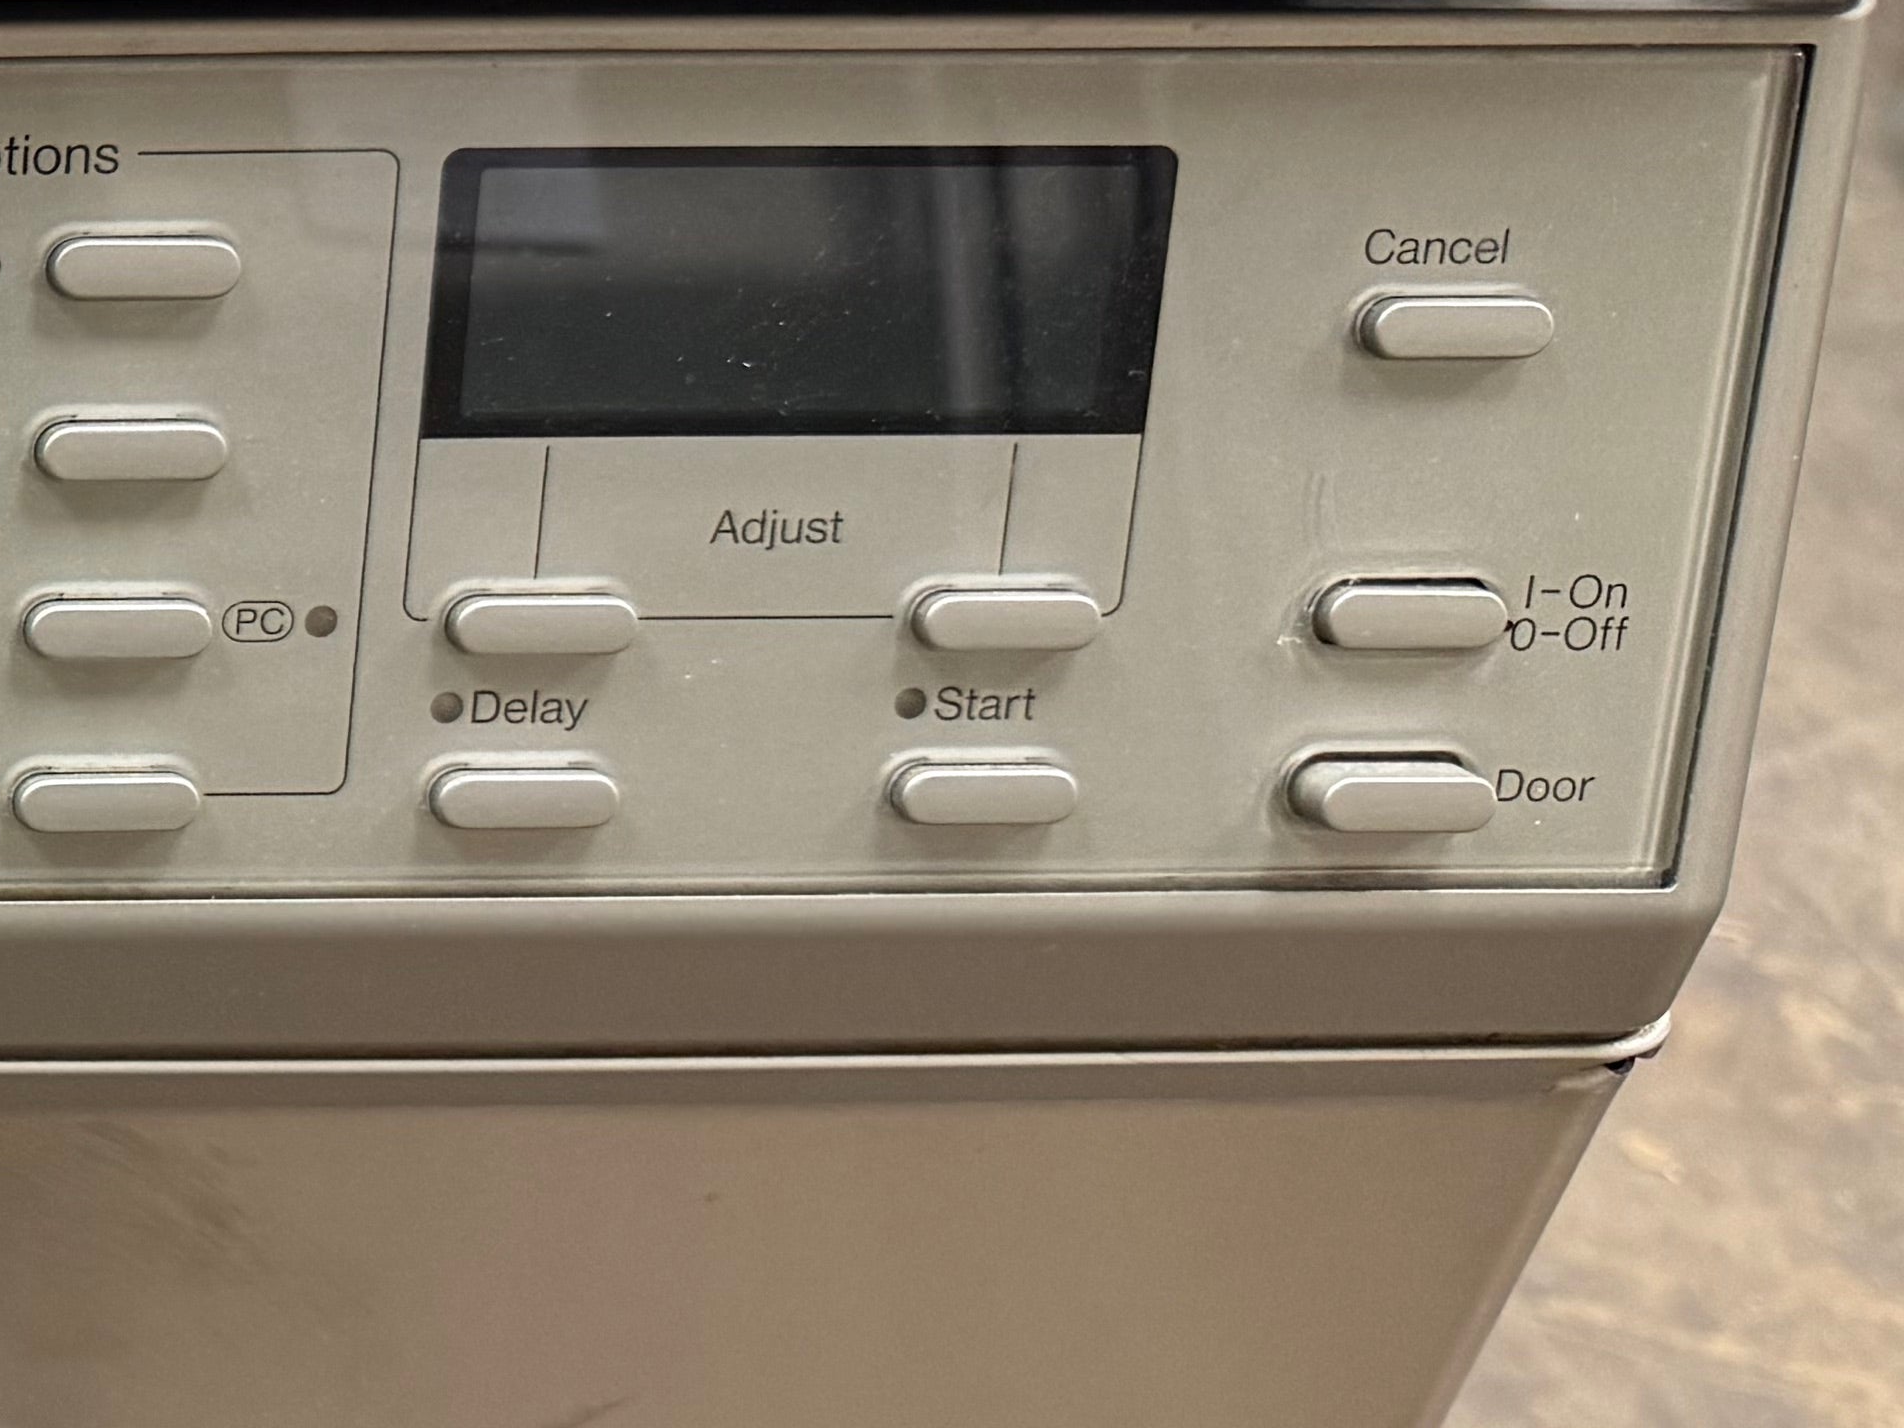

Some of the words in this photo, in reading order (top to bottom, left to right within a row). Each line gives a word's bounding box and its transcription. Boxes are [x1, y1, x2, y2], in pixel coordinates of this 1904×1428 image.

[1363, 226, 1511, 266] Cancel
[708, 507, 845, 550] Adjust
[234, 607, 286, 637] PC
[469, 689, 589, 732] Delay
[932, 685, 1038, 722] Start
[1495, 768, 1597, 803] Door
